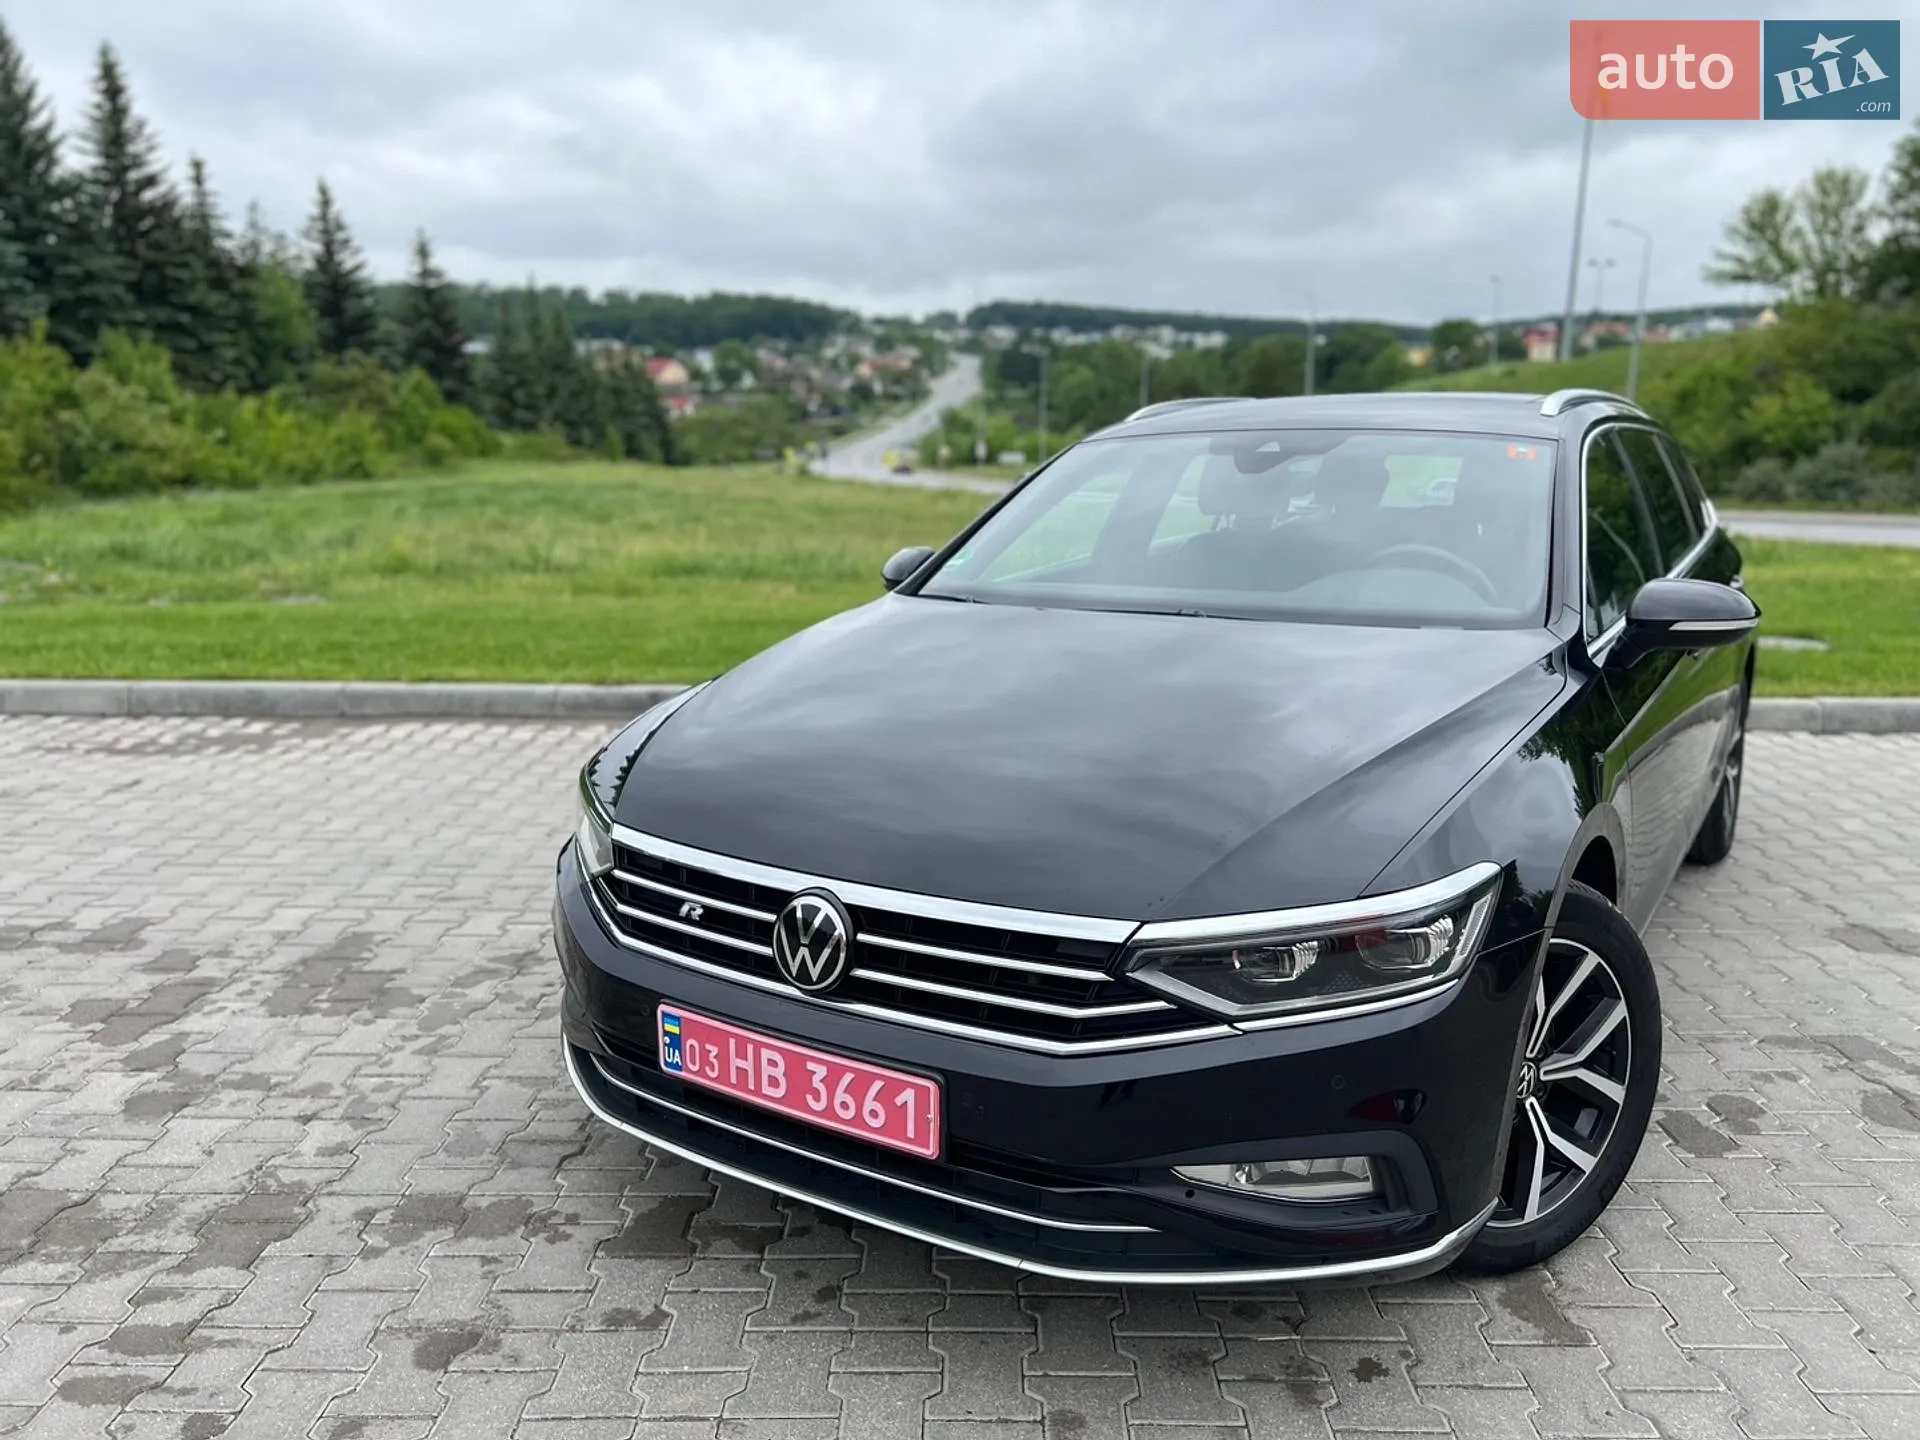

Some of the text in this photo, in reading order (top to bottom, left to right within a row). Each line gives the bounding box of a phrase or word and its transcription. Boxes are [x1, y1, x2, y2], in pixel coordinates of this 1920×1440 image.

[776, 898, 846, 987] VW
[665, 1049, 682, 1067] UA
[685, 1037, 916, 1139] 03 HB 3661
